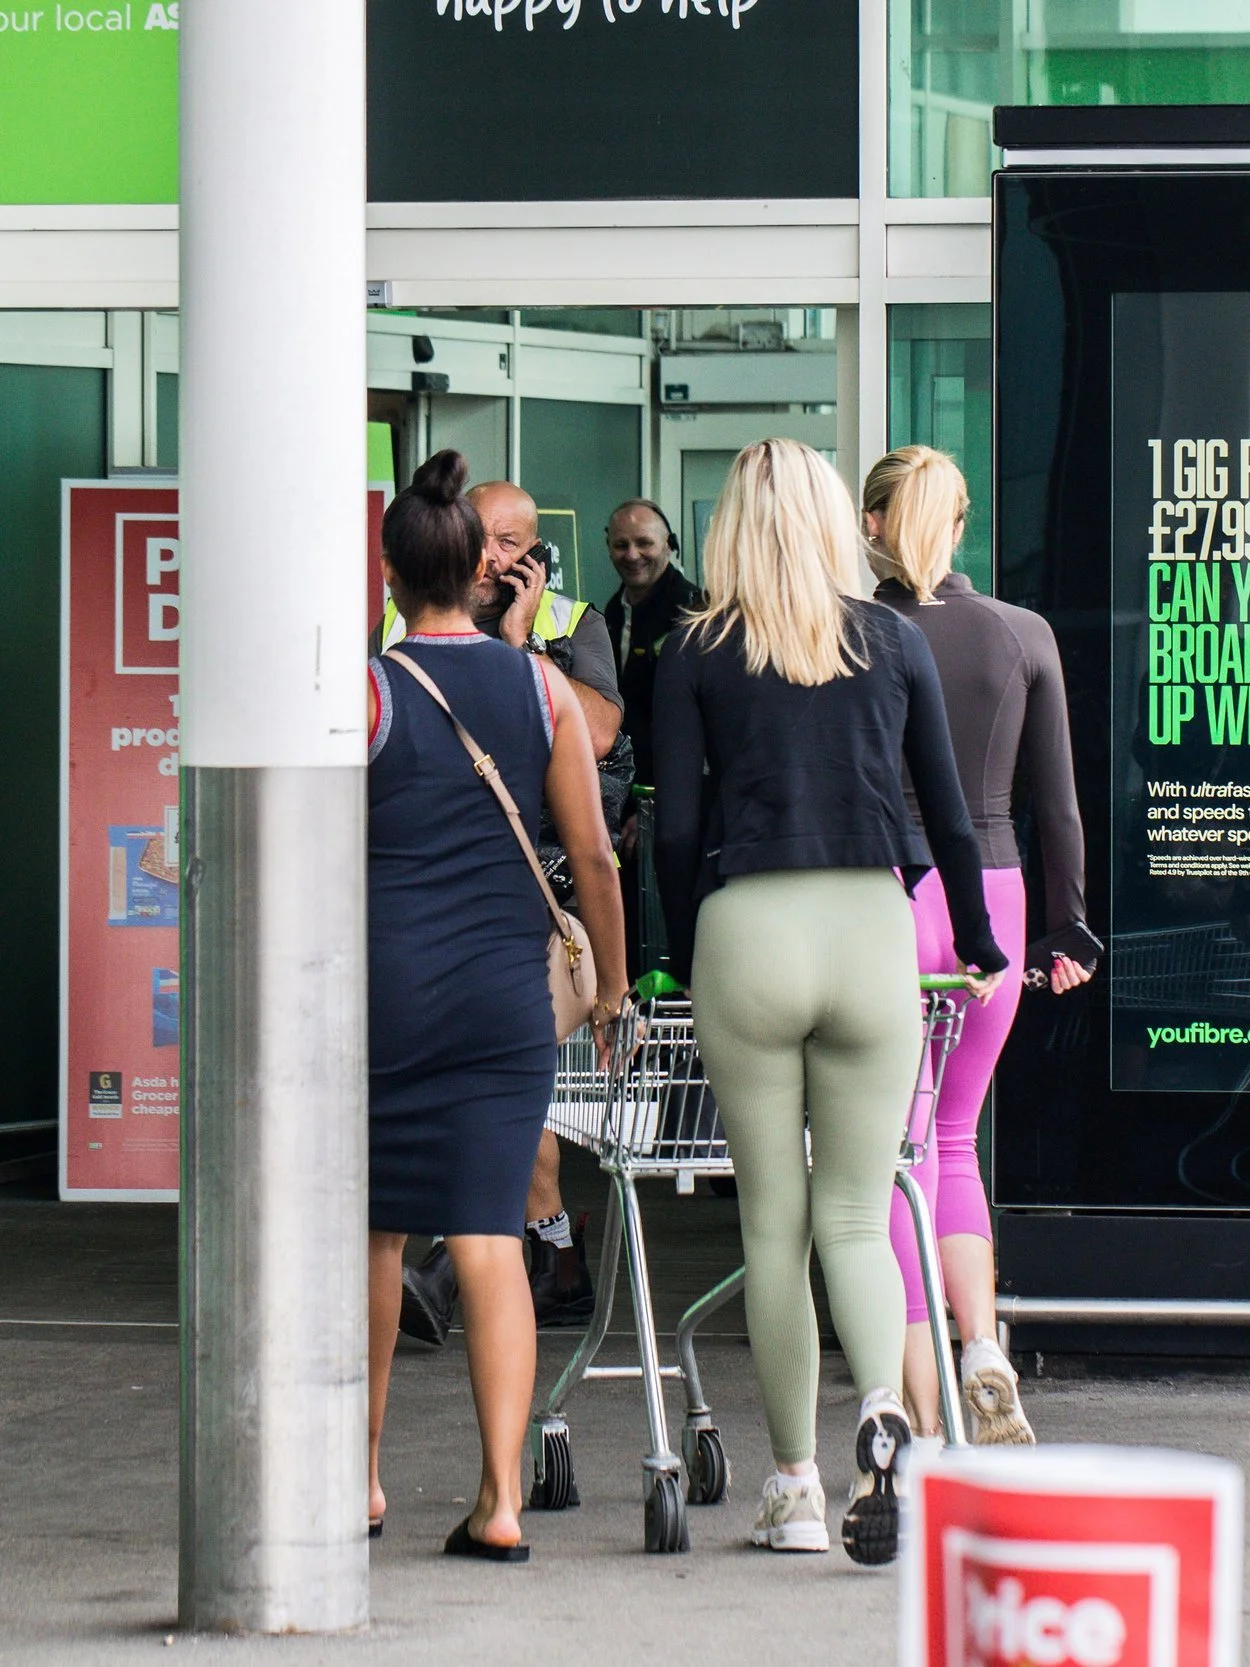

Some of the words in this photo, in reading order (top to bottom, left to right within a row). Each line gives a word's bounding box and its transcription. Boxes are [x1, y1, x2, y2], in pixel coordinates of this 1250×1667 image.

[56, 4, 131, 31] local
[1148, 439, 1162, 499] 1
[1173, 439, 1228, 499] GIG
[1148, 562, 1220, 622] CAN
[1148, 685, 1194, 745] UP
[1147, 781, 1187, 798] With
[1147, 803, 1180, 820] and
[1183, 803, 1245, 824] speeds
[1147, 826, 1225, 842] whatever
[132, 1077, 167, 1087] Asda
